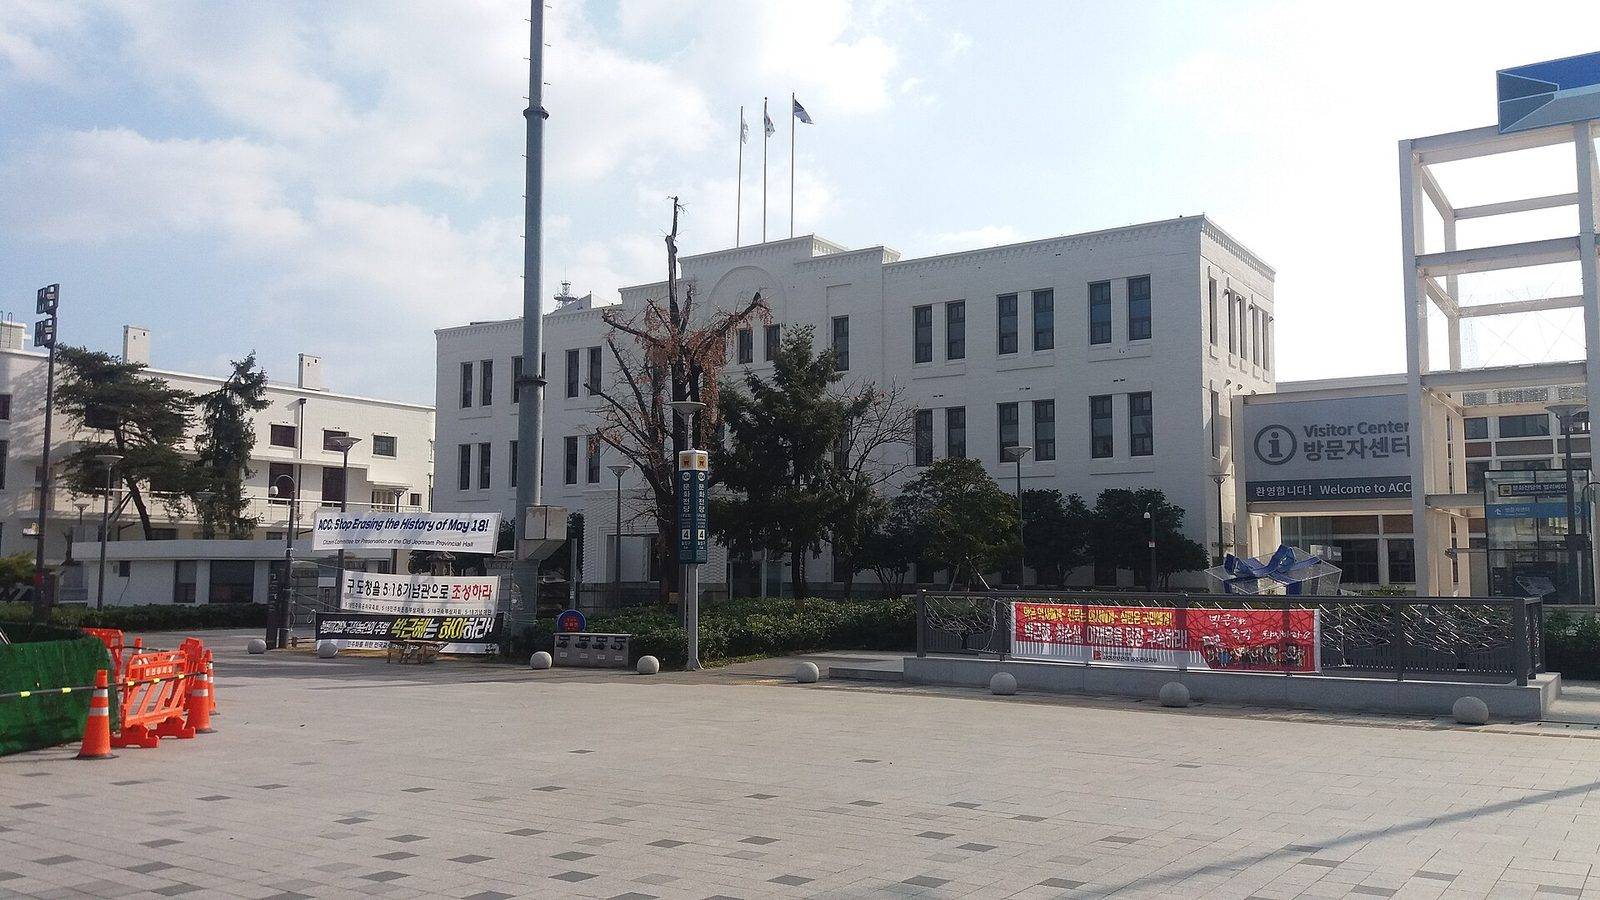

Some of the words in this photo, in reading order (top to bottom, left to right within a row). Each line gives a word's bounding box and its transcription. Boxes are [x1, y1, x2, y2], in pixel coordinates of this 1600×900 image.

[1303, 423, 1354, 438] Visitor
[1357, 420, 1410, 435] Center
[1303, 436, 1411, 462] 방문자센터
[1255, 485, 1312, 497] 환영합니다!
[1320, 483, 1371, 495] Welcome
[1374, 484, 1386, 494] to
[1388, 482, 1411, 493] ACC
[334, 518, 352, 531] Stop
[352, 518, 383, 531] Erasing
[385, 518, 400, 530] the
[400, 518, 435, 532] History
[436, 518, 449, 531] of
[447, 519, 470, 533] May
[471, 519, 489, 532] 18!
[347, 579, 355, 594] 구
[356, 580, 380, 597] 도청을
[452, 584, 493, 601] 조성하라
[391, 617, 439, 639] 박근혜는
[1086, 625, 1122, 646] 이재용을
[1125, 627, 1144, 647] 당장
[1147, 628, 1188, 649] 구속하라!
